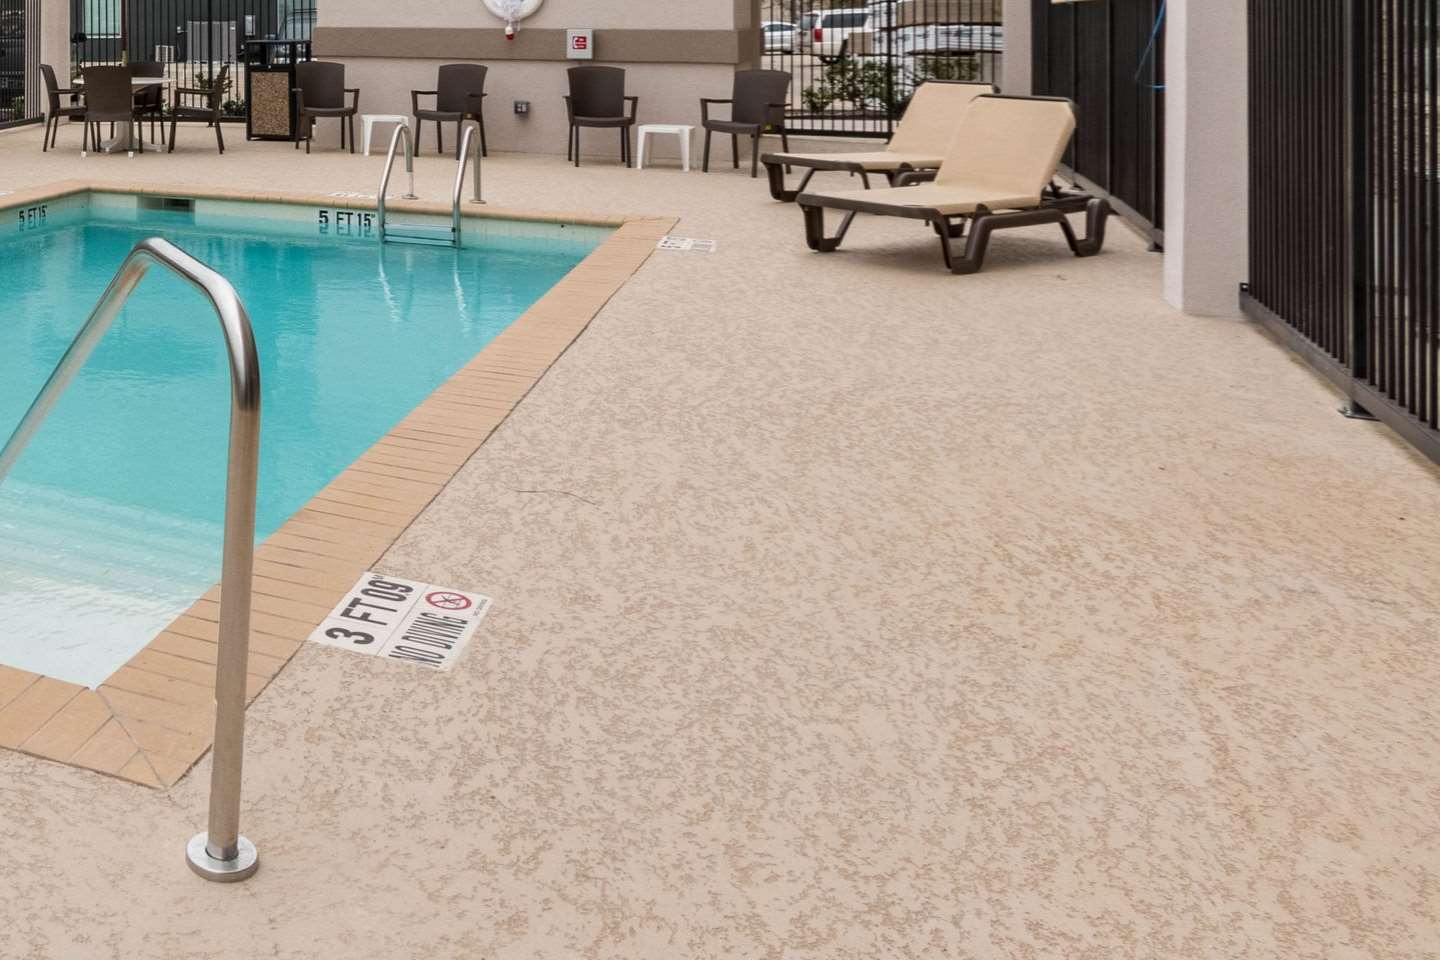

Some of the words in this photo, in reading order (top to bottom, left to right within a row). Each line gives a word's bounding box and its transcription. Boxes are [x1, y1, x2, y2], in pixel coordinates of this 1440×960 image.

[319, 209, 329, 224] 5
[336, 211, 353, 225] FT
[340, 597, 398, 626] FT
[325, 627, 375, 645] 3
[401, 612, 468, 650] DIVING
[388, 645, 445, 667] NO
